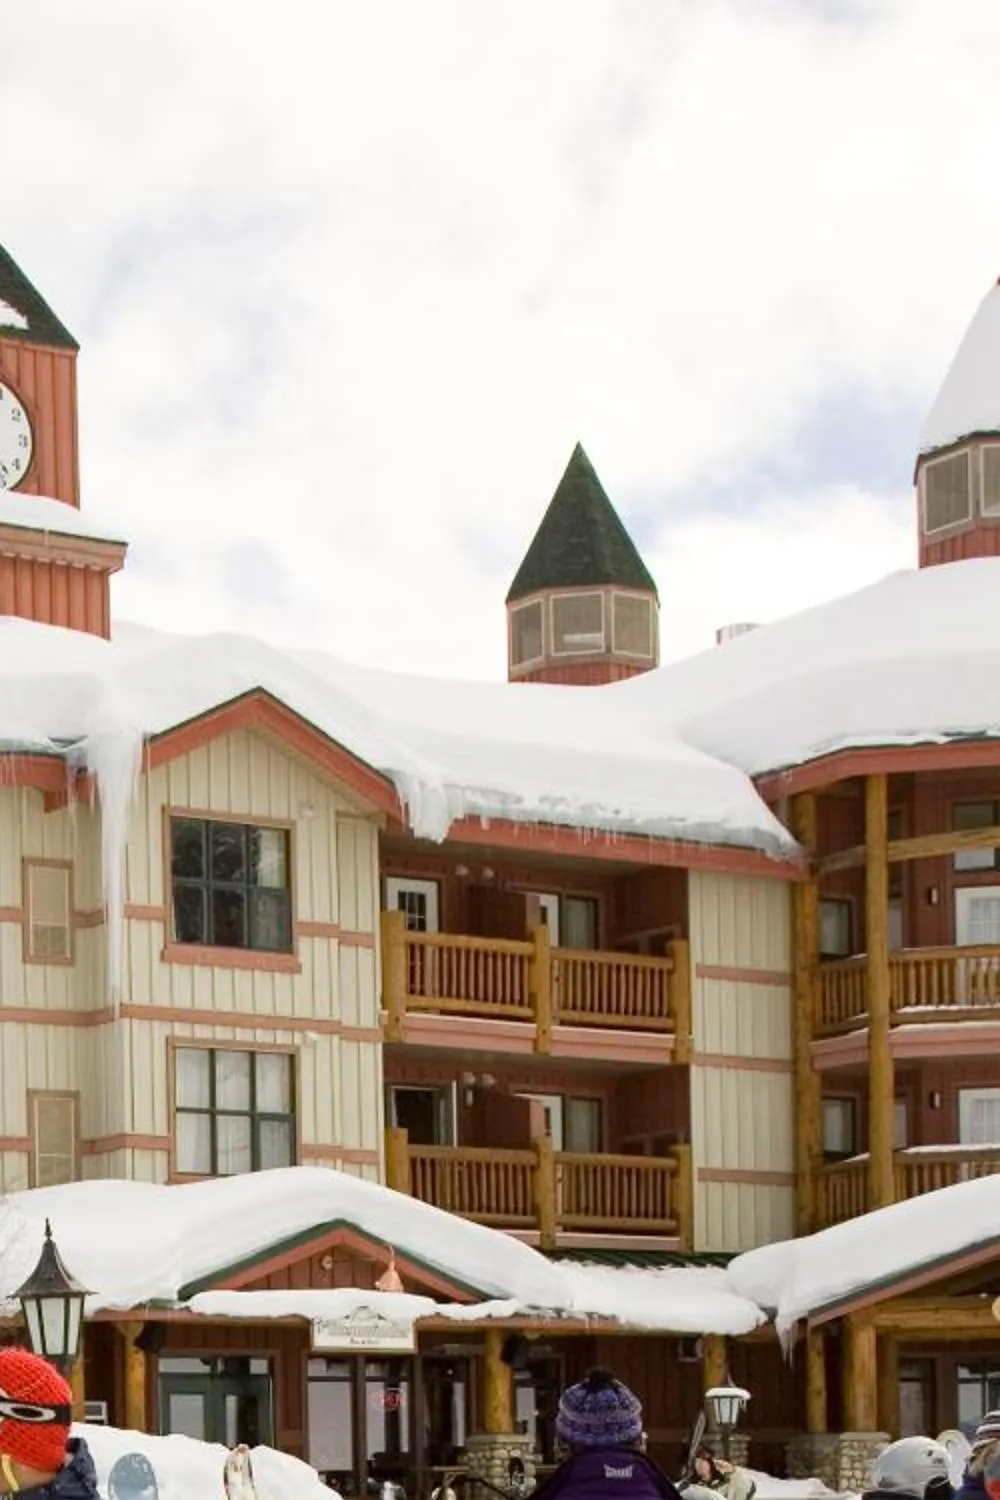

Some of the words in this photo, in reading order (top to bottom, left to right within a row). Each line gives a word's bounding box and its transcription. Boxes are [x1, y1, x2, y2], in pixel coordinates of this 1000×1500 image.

[11, 407, 22, 422] 2
[18, 433, 28, 449] 3
[11, 457, 21, 471] 4
